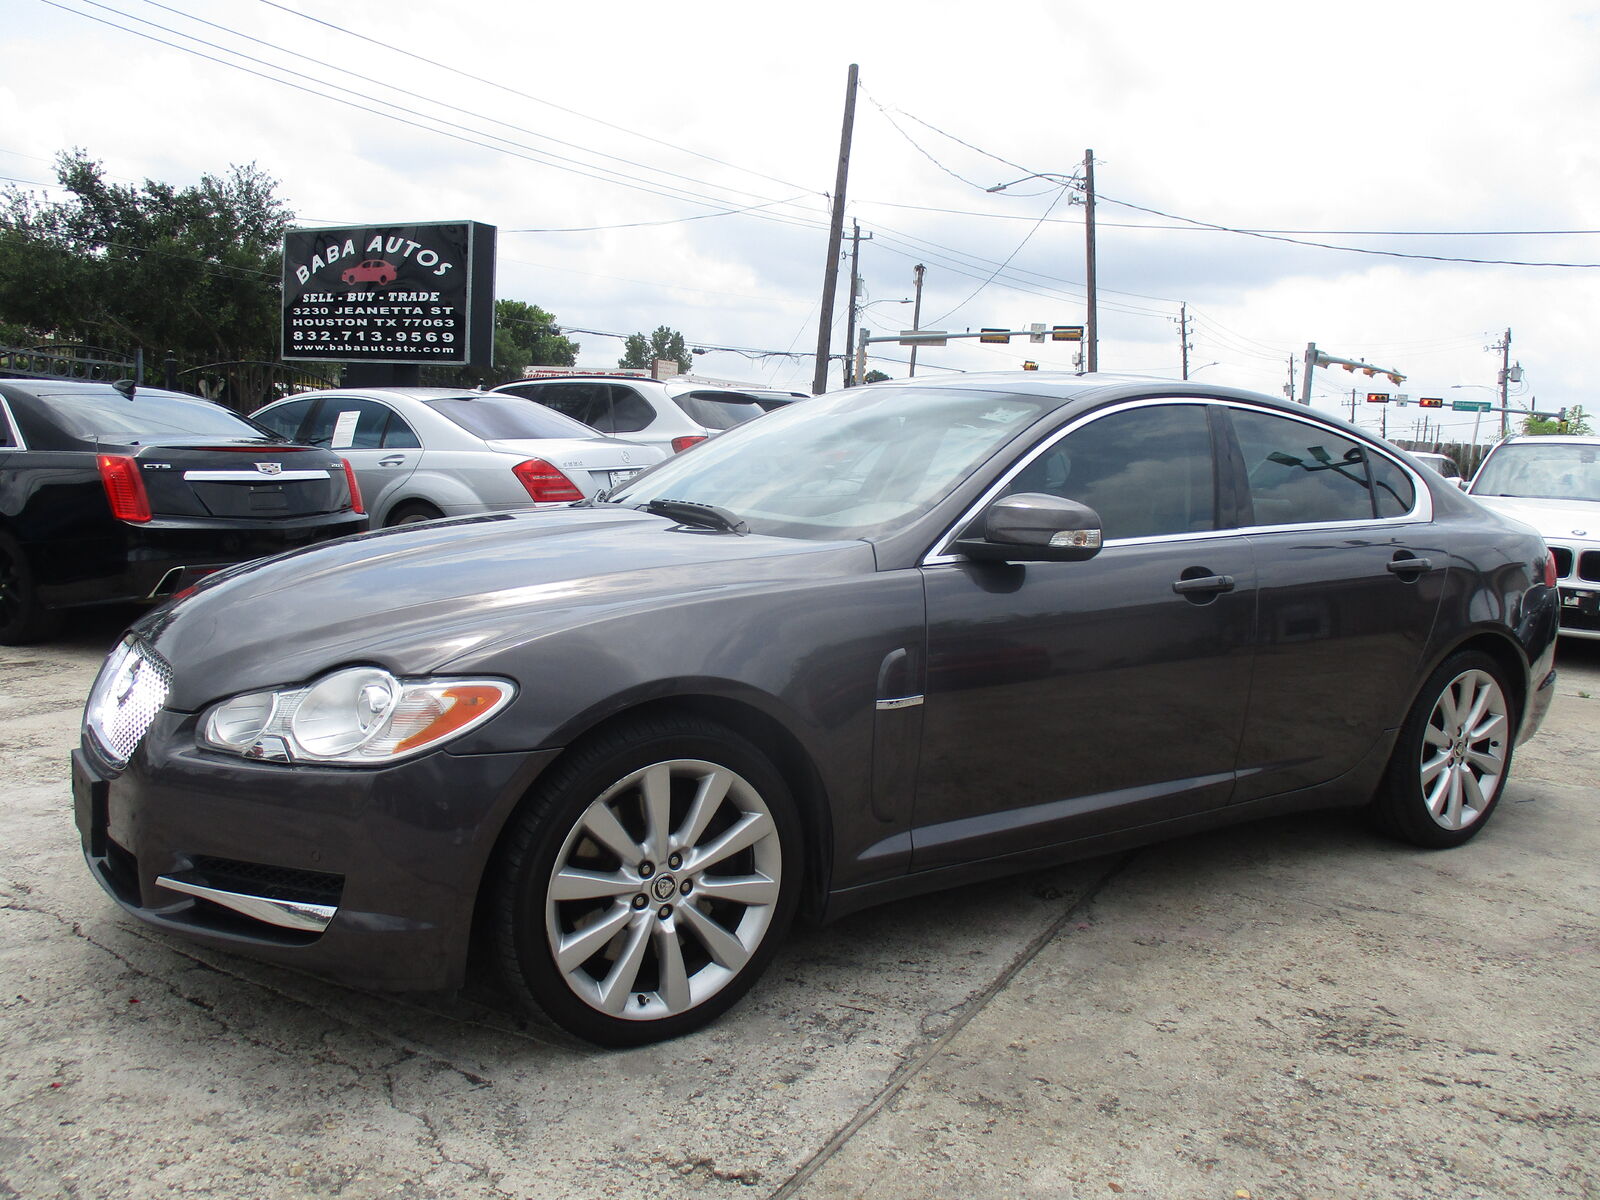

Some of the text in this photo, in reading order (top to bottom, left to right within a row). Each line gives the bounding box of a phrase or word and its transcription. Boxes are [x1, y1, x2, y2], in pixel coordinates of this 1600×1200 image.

[295, 235, 453, 285] BABA AUTOS
[302, 293, 334, 303] SELL
[347, 292, 375, 302] BUY
[388, 292, 440, 302] TRADE
[293, 306, 454, 315] 3230 JEANETTA ST
[292, 318, 455, 327] HOUSTON TX 77063
[293, 331, 455, 343] 832.713.9569
[293, 344, 455, 354] www.babaautostx.com
